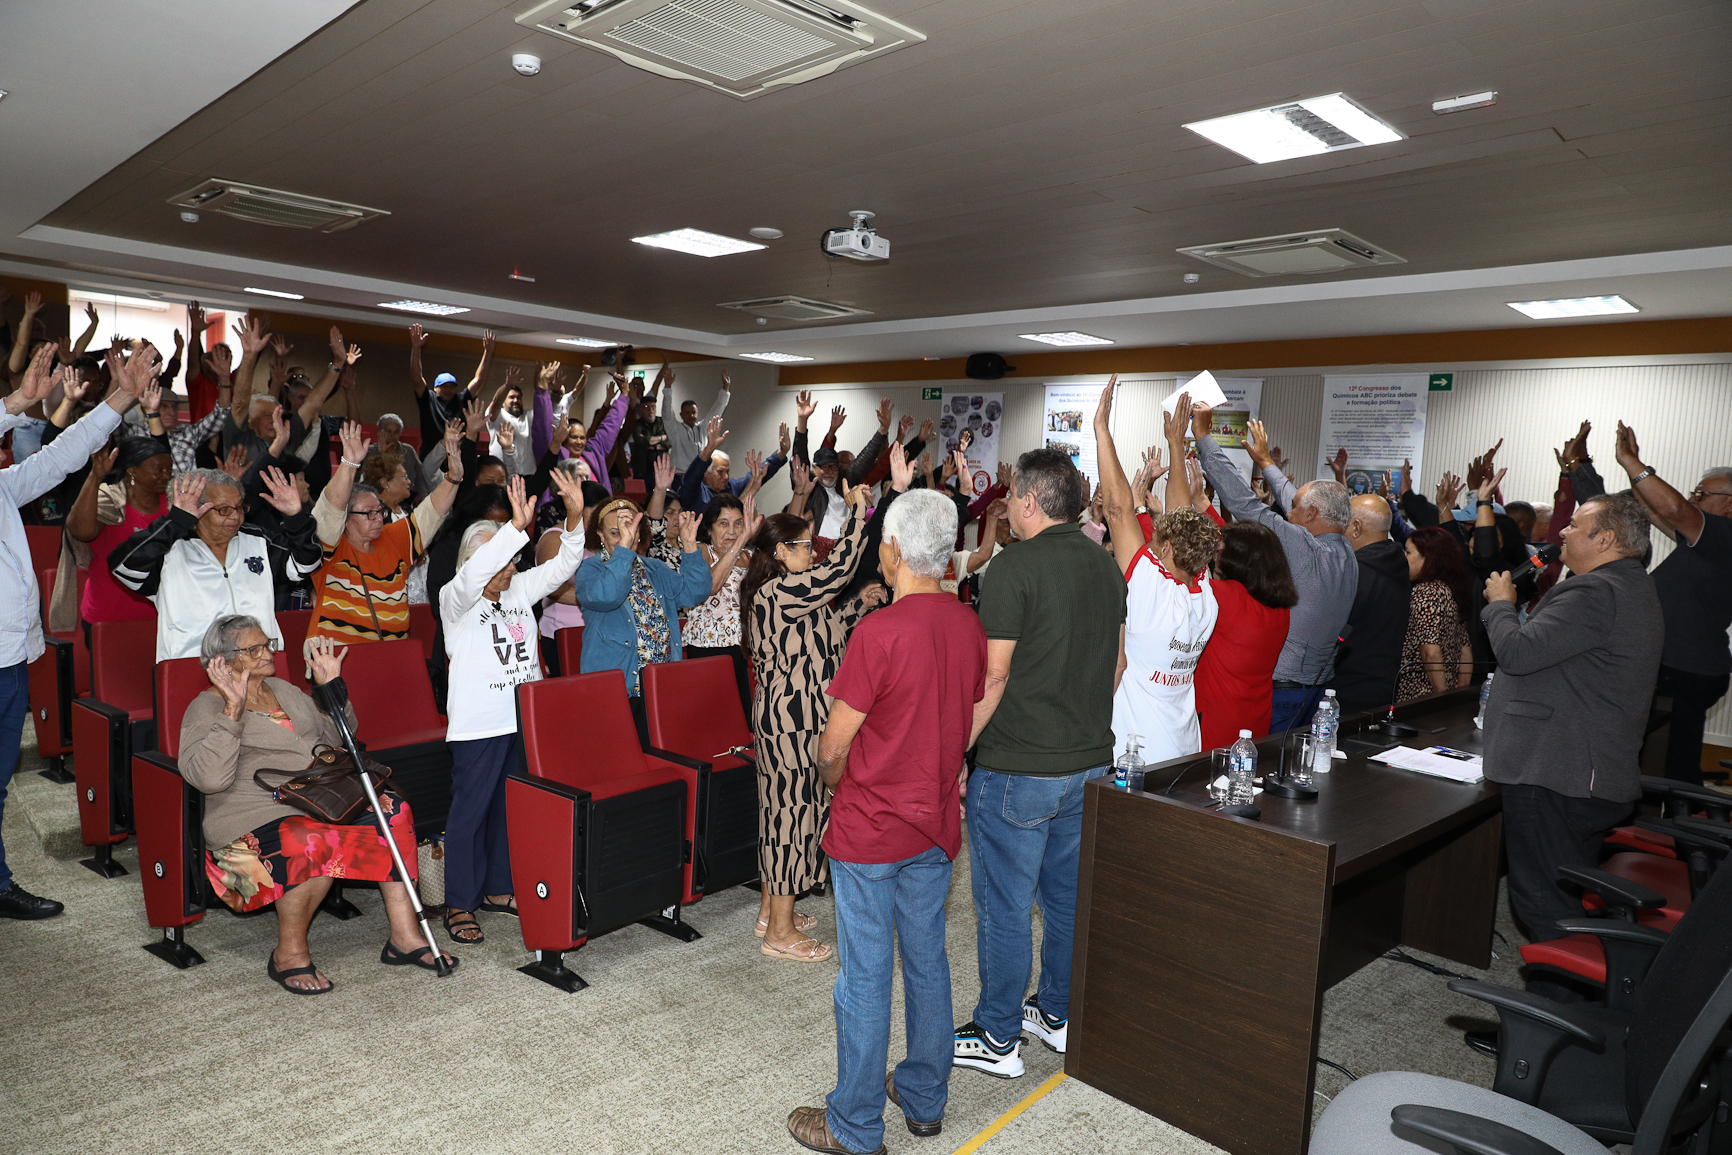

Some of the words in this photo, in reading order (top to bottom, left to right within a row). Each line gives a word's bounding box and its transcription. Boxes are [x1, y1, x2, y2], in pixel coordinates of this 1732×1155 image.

[479, 610, 490, 626] all
[504, 663, 520, 676] and
[489, 682, 506, 691] cup
[539, 886, 545, 896] A
